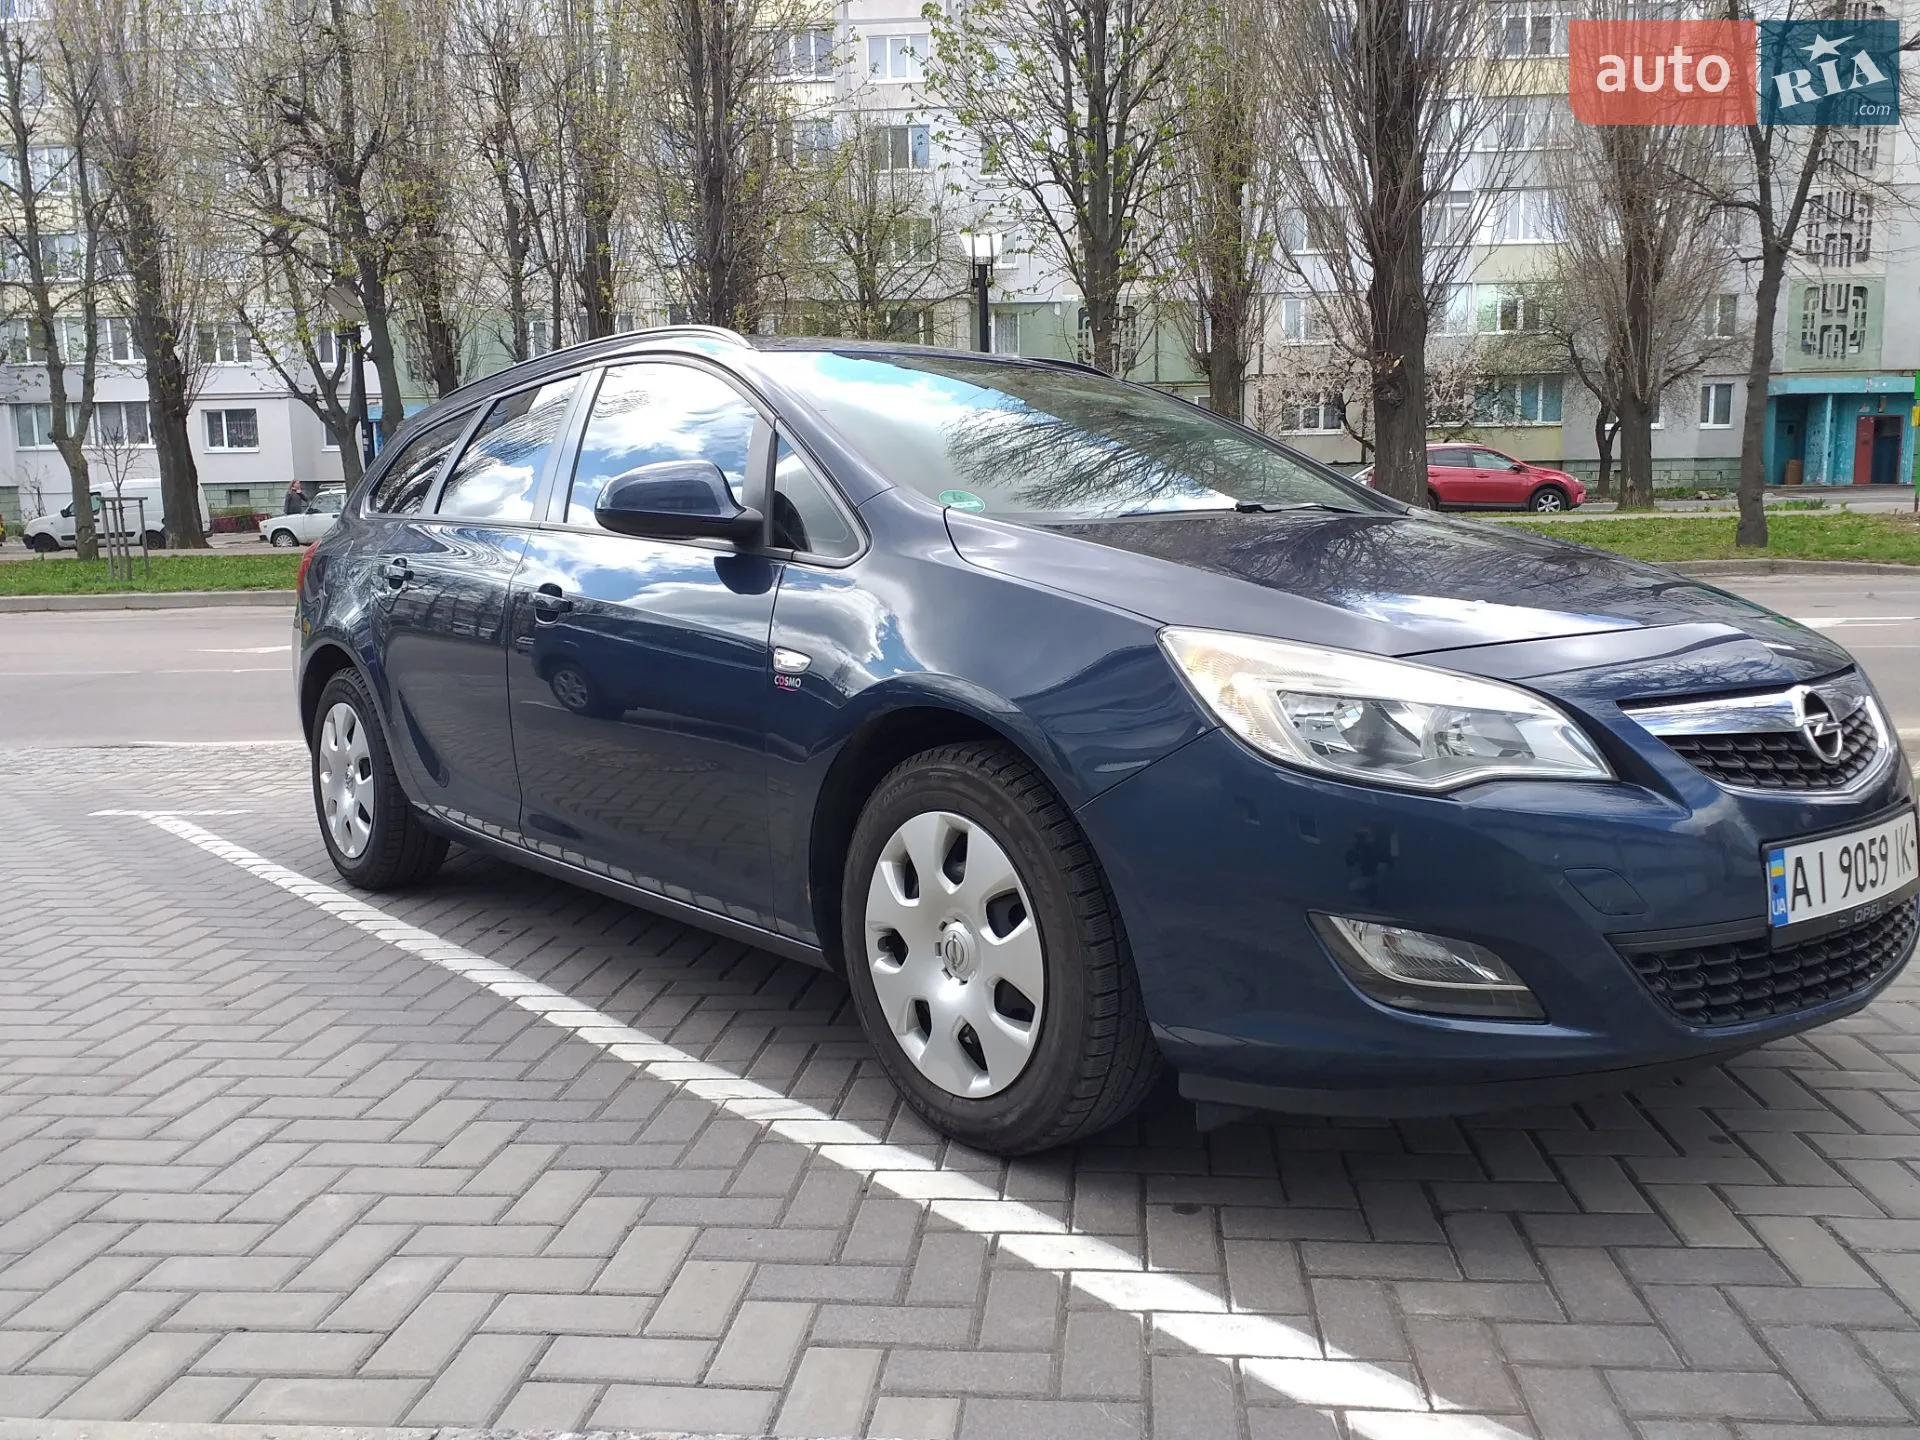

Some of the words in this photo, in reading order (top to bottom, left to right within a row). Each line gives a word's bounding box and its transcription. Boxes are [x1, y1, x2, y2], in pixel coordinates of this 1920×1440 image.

[774, 675, 802, 688] COSMO
[1791, 851, 1826, 911] AI
[1839, 834, 1889, 899] 9059
[1895, 822, 1912, 877] IK
[1772, 898, 1788, 915] UA
[1854, 903, 1882, 923] OPEL
